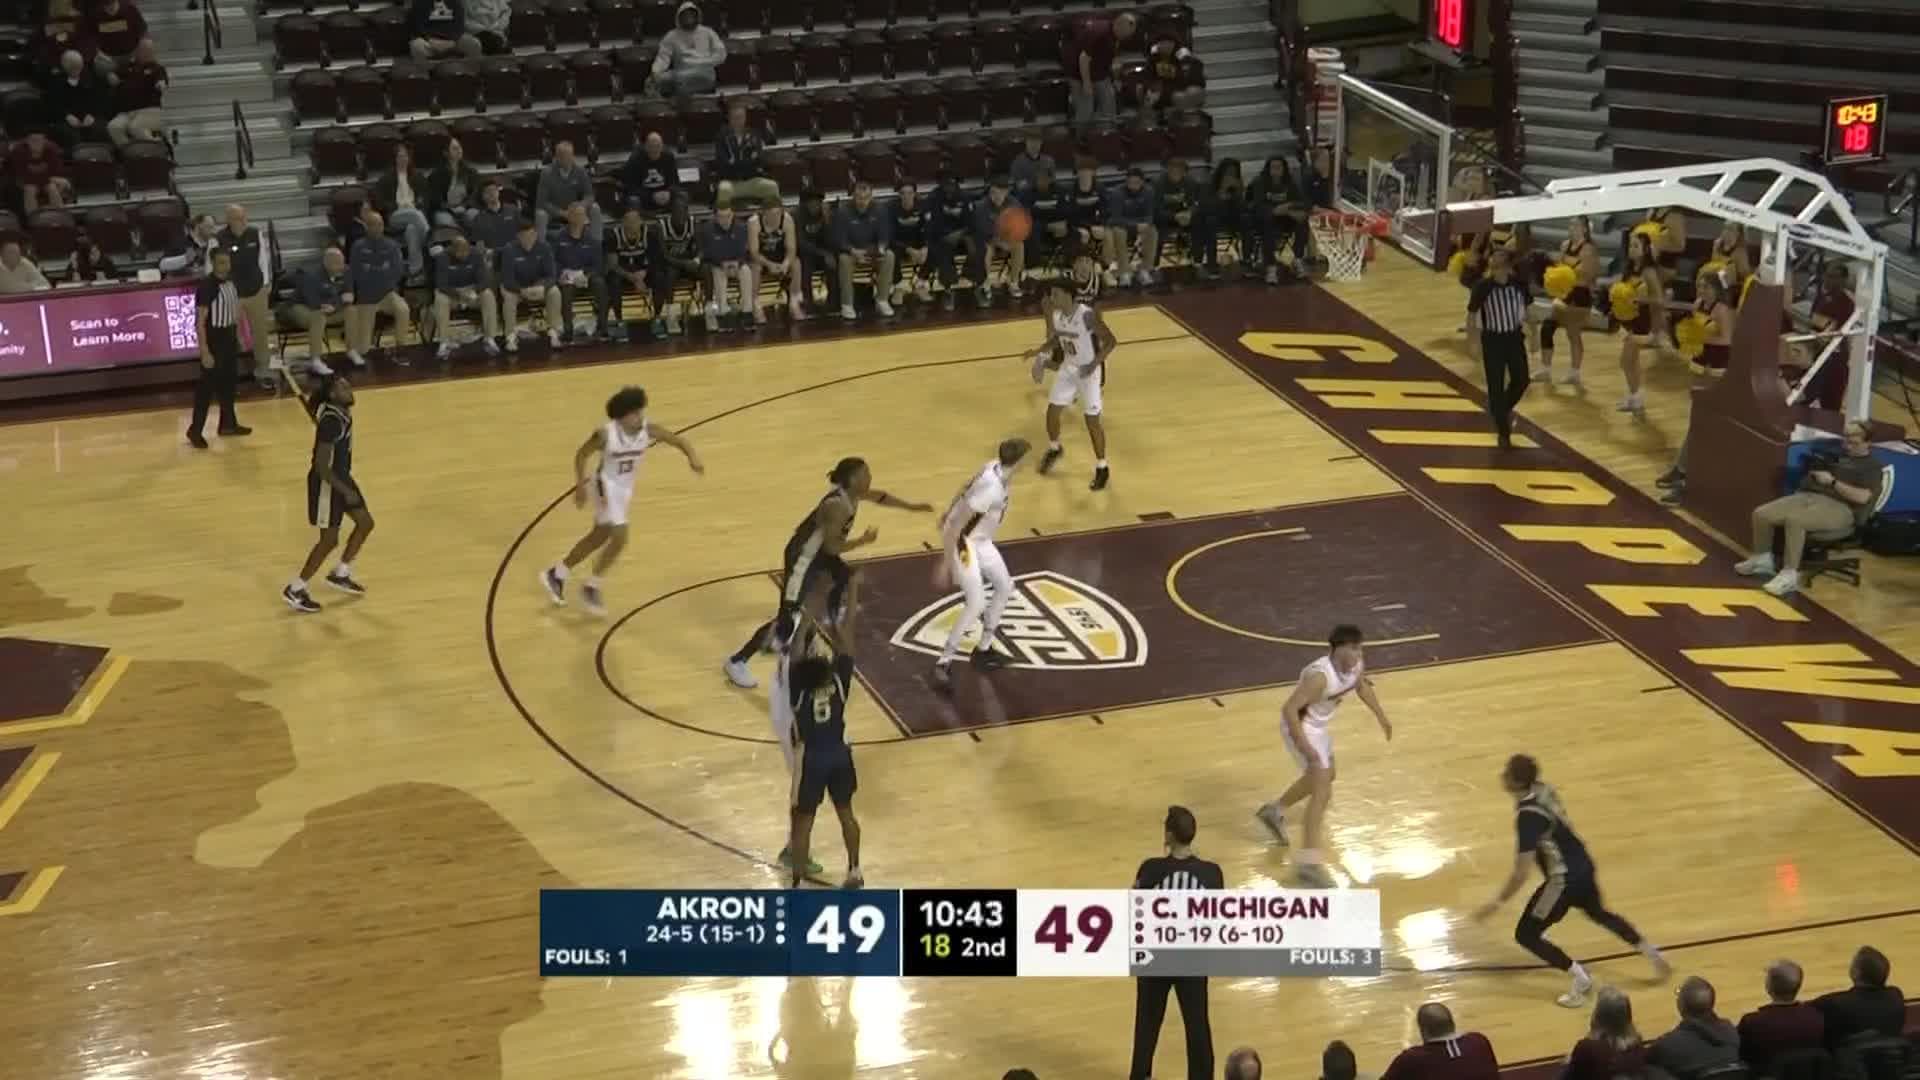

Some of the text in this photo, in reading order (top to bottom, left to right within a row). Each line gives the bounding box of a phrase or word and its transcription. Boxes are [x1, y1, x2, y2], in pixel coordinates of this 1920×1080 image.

[1845, 124, 1868, 150] 18
[70, 317, 119, 331] Scan to
[73, 331, 145, 347] Learn More
